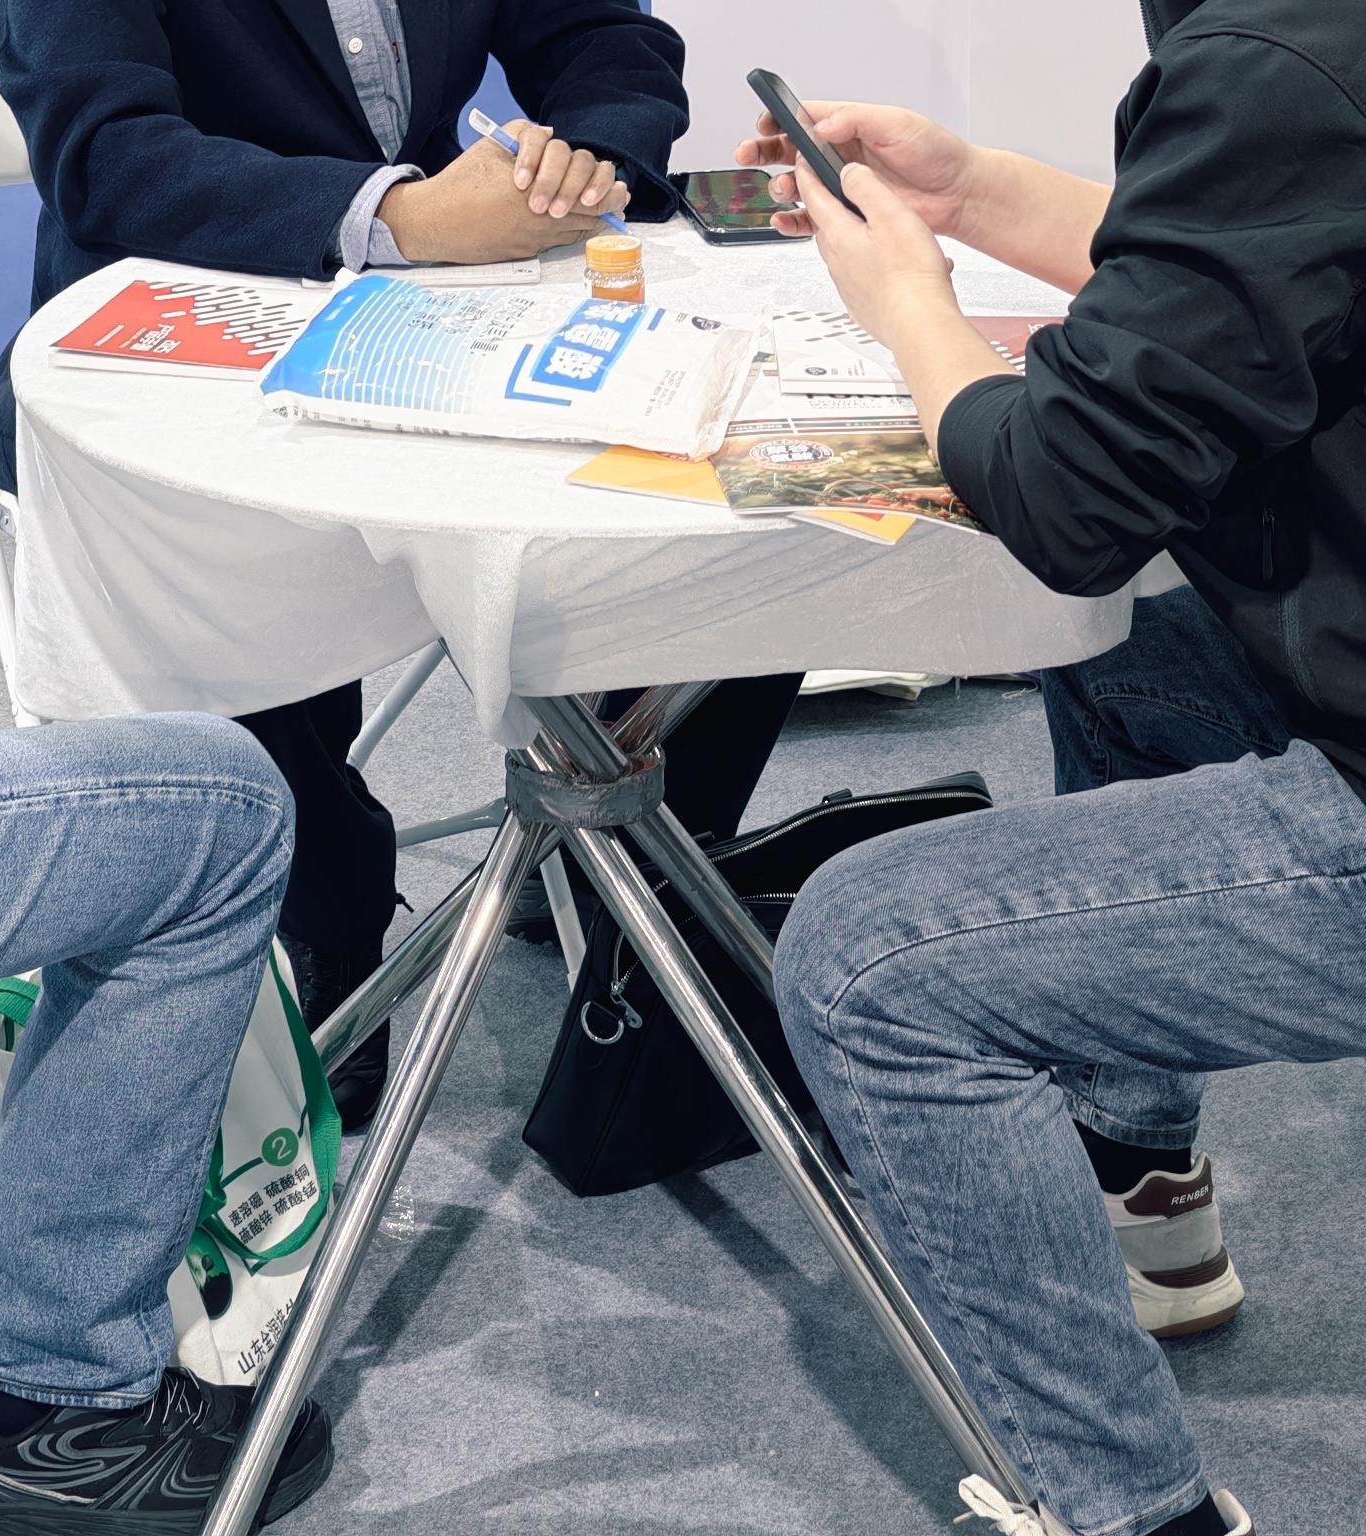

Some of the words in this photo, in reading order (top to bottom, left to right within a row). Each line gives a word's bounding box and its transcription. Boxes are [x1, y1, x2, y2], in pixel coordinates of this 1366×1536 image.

[271, 1136, 292, 1160] 2
[228, 1191, 264, 1229] 速溶硼
[264, 1163, 311, 1200] 硫酸铜
[238, 1211, 274, 1245] 硫酸锌
[273, 1180, 318, 1216] 硫酸锰
